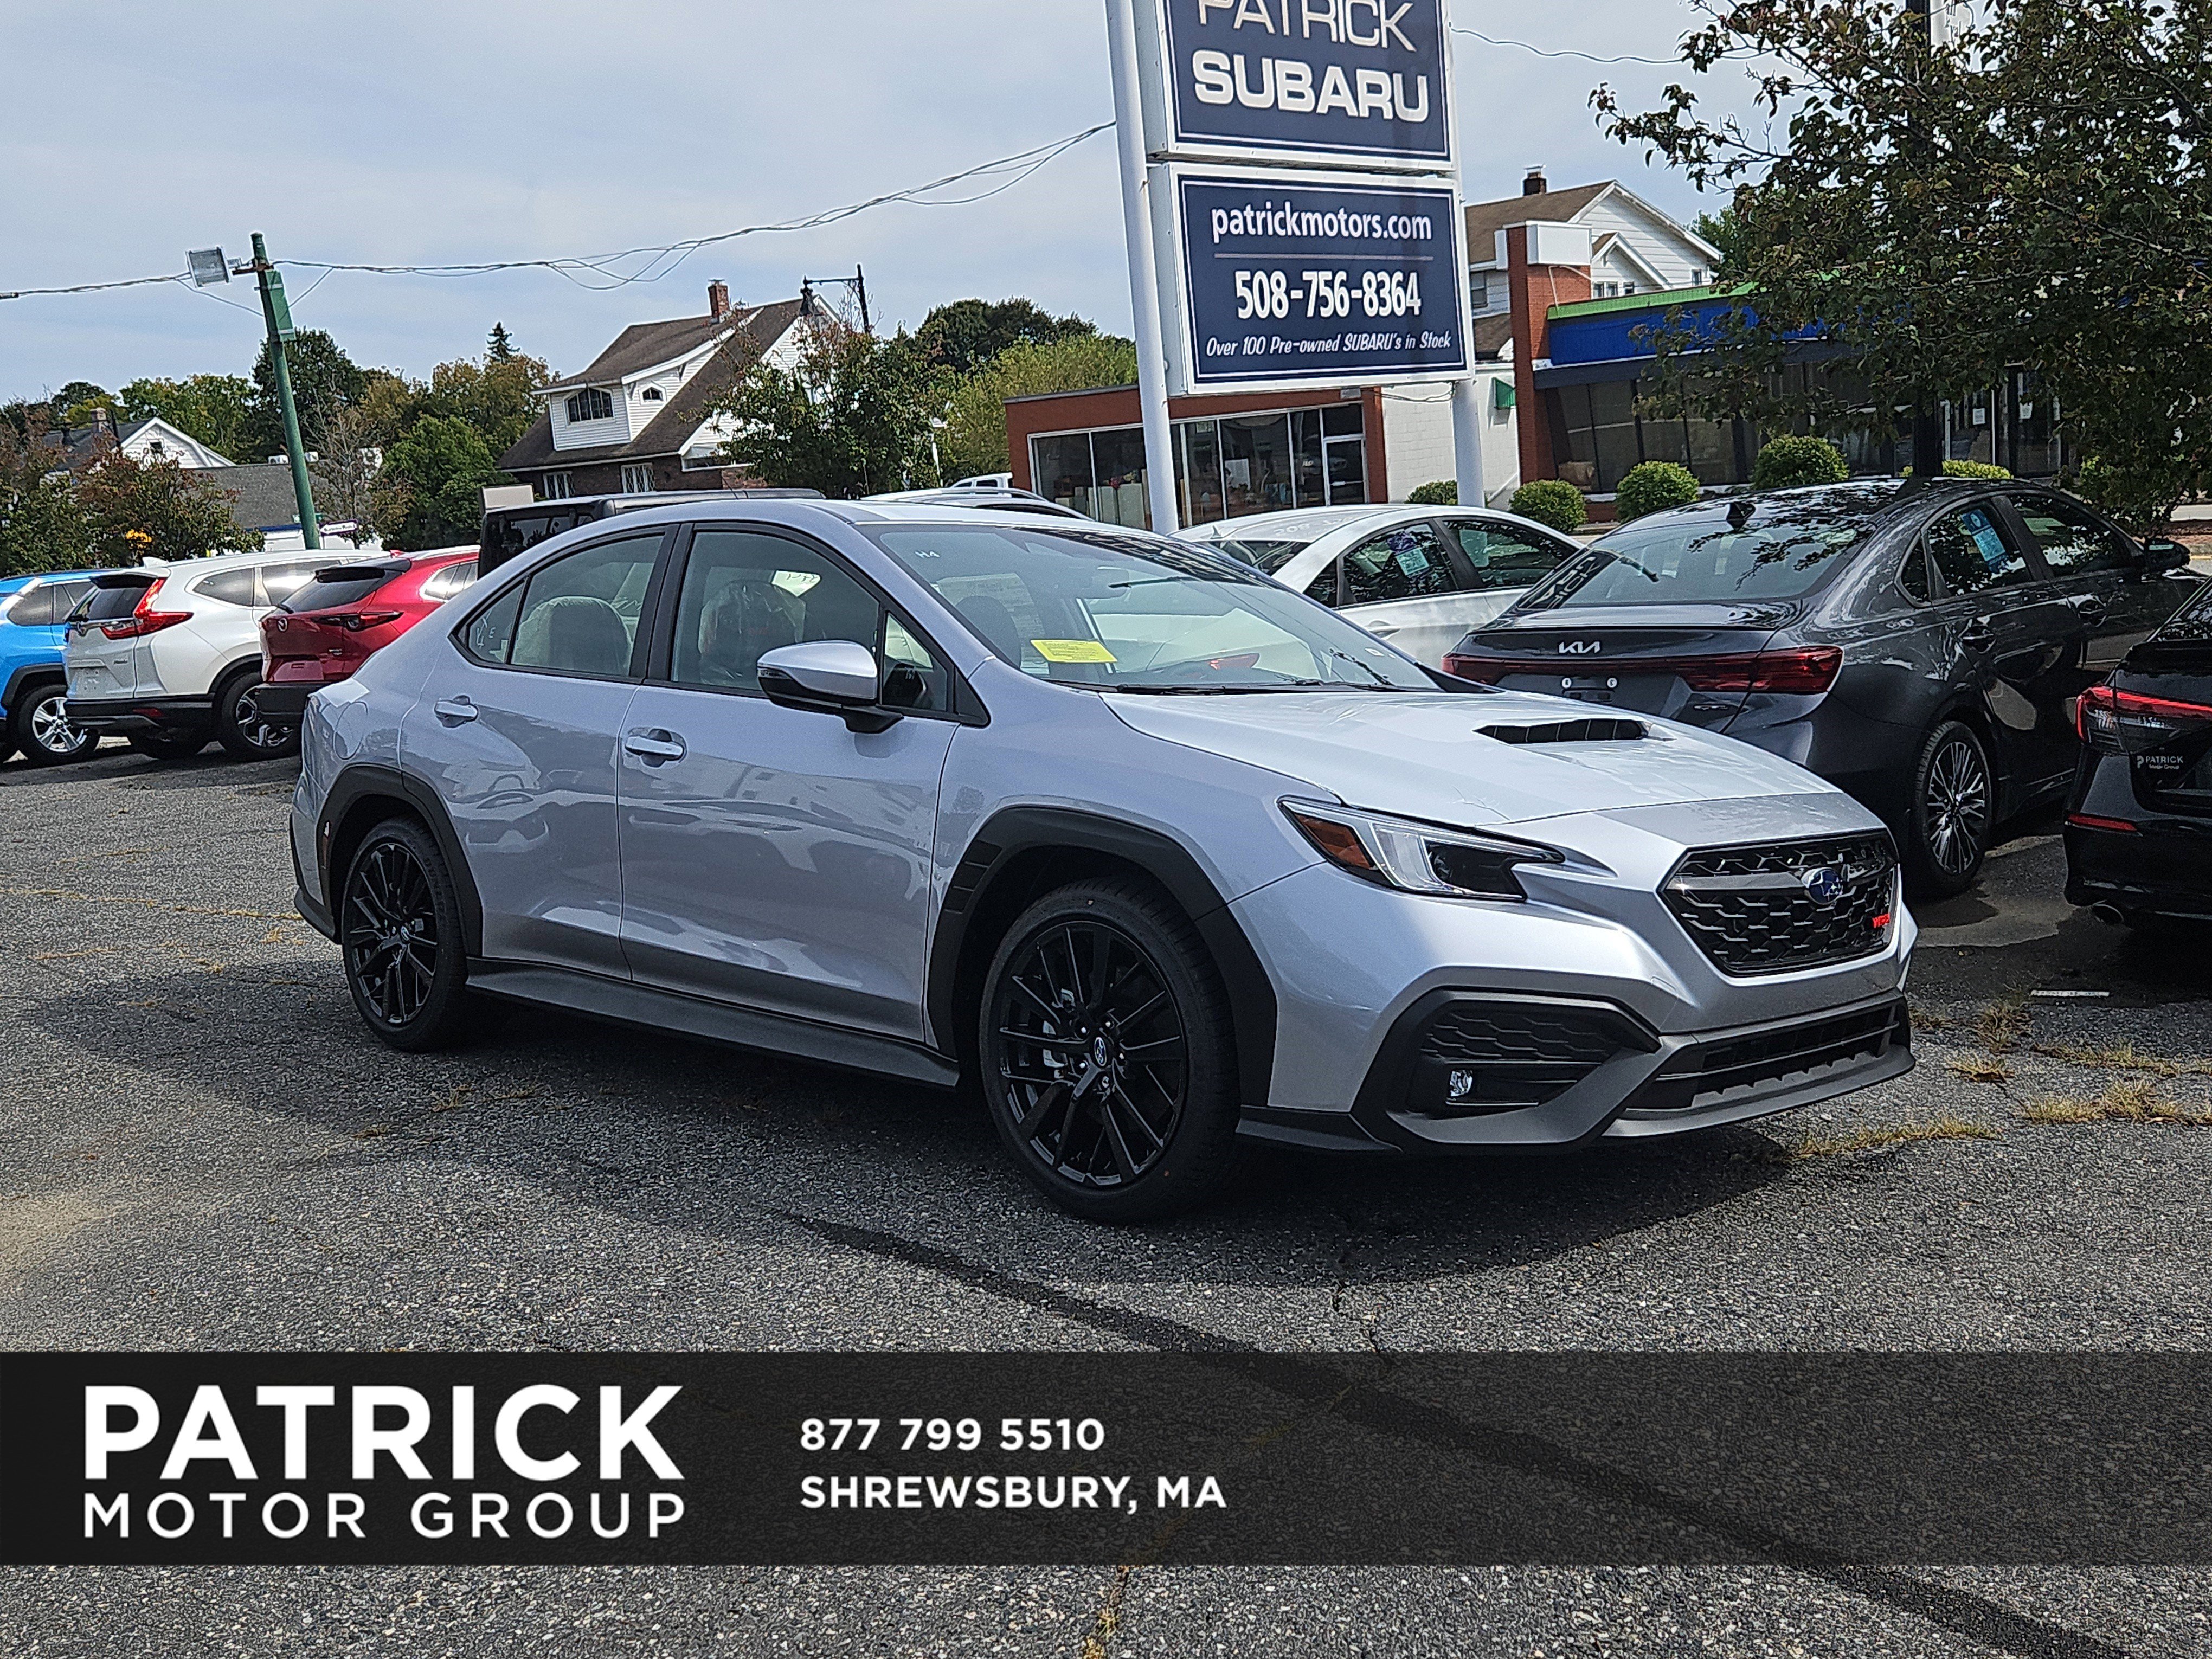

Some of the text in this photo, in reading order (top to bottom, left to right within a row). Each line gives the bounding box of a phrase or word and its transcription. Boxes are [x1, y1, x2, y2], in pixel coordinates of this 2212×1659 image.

[1192, 50, 1429, 123] SUBARU
[1211, 201, 1432, 243] patrickmotors.com
[1235, 271, 1422, 319] 508-756-8364
[1206, 331, 1452, 356] Over 100 Pre-owned SUBARU's in Stock
